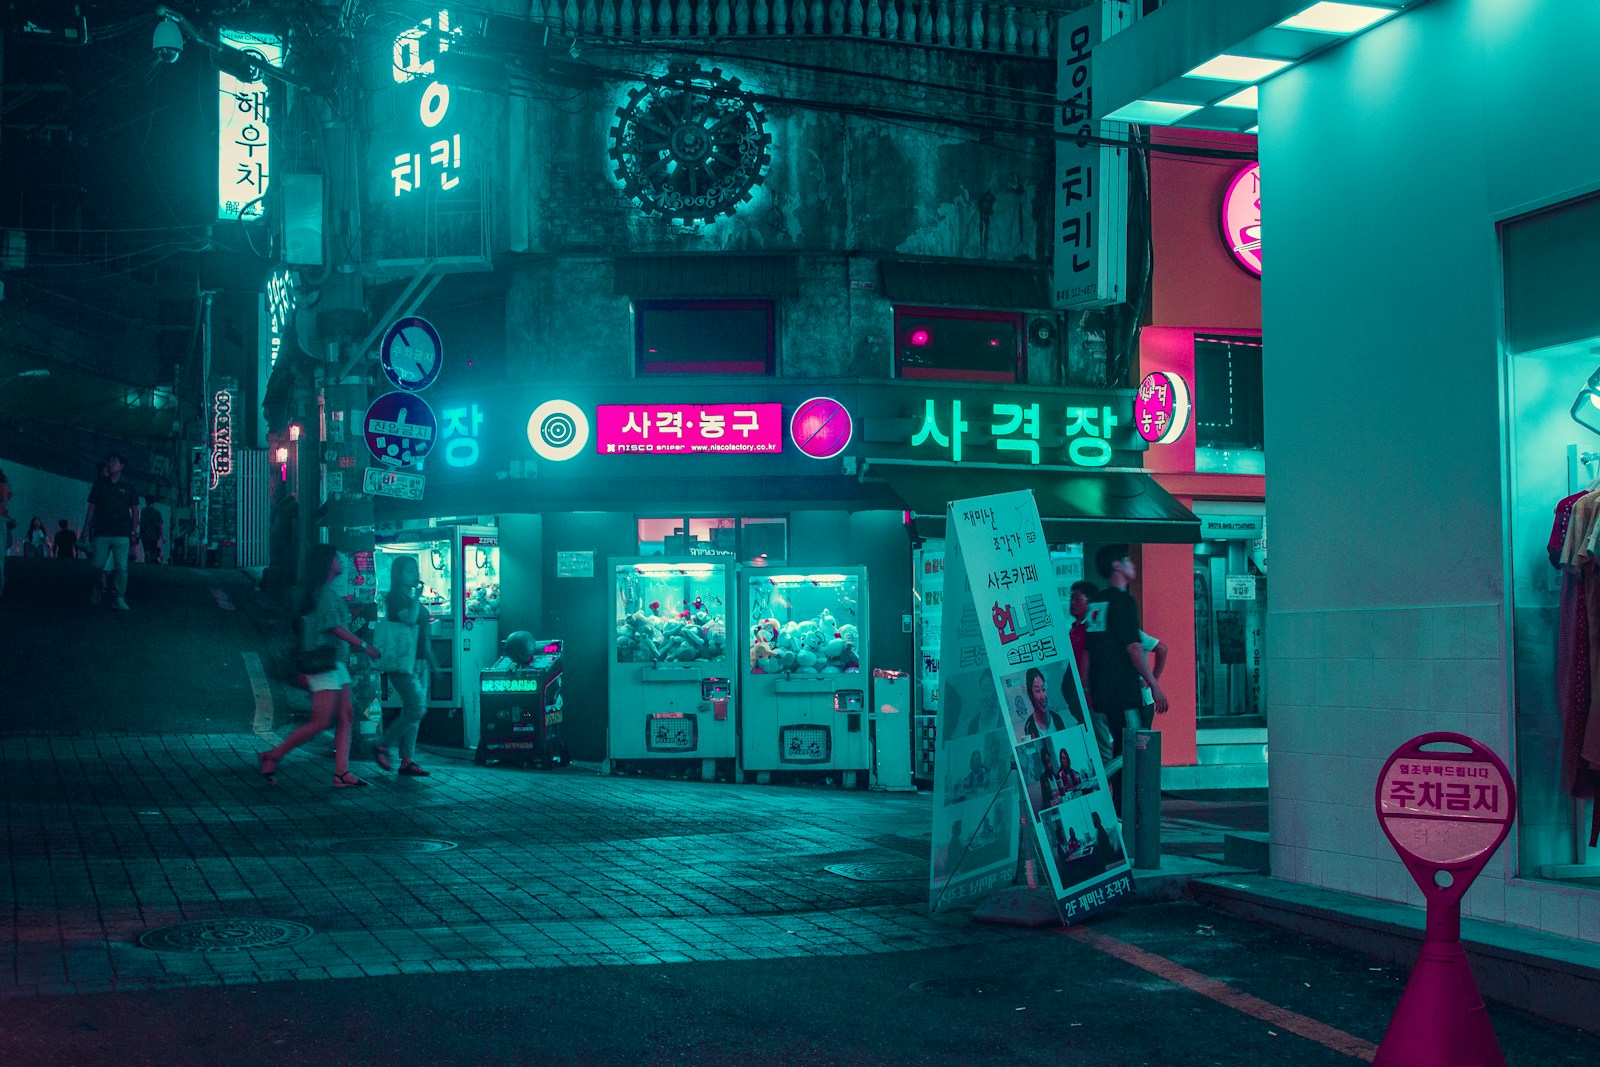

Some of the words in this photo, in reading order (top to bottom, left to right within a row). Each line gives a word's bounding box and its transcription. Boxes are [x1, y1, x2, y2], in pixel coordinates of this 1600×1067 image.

[235, 91, 269, 195] 해우차
[390, 133, 461, 197] 치킨
[1061, 165, 1091, 273] 치킨
[392, 345, 433, 363] 주차금지
[1141, 383, 1168, 408] 사격
[374, 421, 428, 439] 진입금지
[442, 404, 483, 468] 장
[911, 399, 1118, 467] 사격장
[1140, 408, 1167, 434] 농구
[691, 442, 776, 452] www.niscofactory.co.kr
[962, 507, 998, 531] 재미난
[992, 532, 1021, 558] 조각가
[987, 563, 1039, 590] 사주카페
[991, 593, 1054, 646] 언니들의
[1006, 635, 1058, 666] 슬램덩크
[1389, 780, 1499, 813] 주차금지
[1065, 899, 1078, 918] 2F
[1077, 887, 1106, 911] 재미난
[1104, 876, 1131, 899] 조각가
